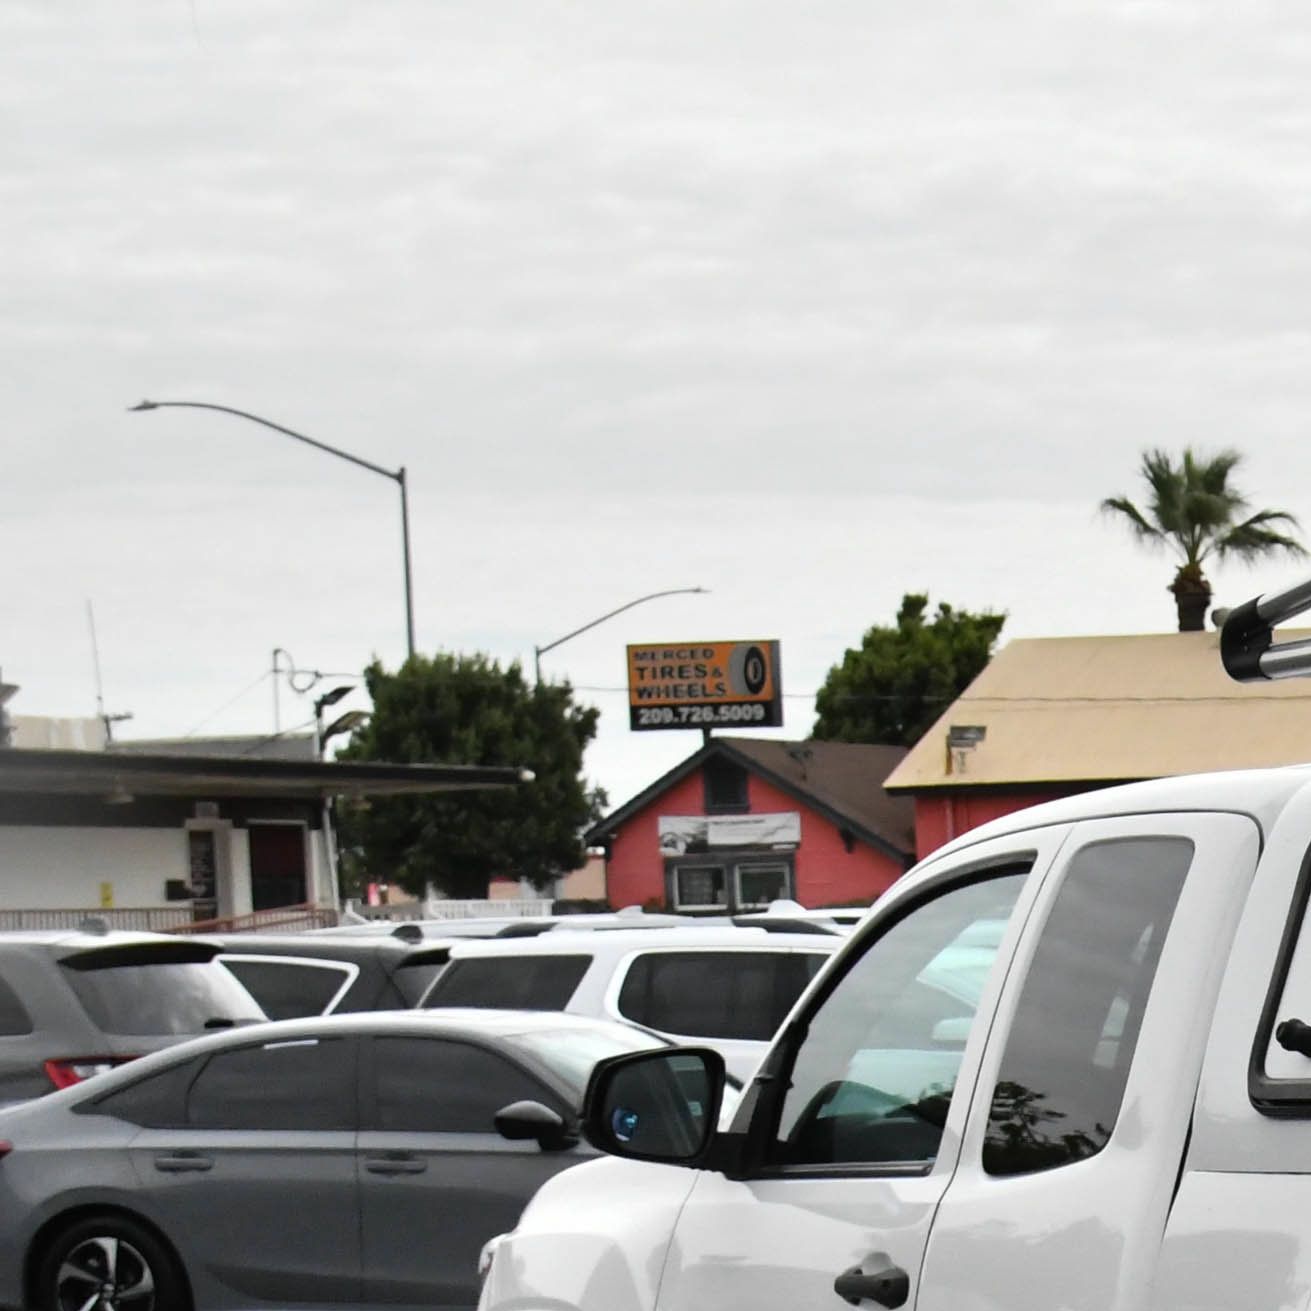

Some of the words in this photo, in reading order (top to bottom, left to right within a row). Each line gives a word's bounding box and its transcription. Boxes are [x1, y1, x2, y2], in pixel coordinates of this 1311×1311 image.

[633, 649, 714, 661] MERCED
[636, 663, 708, 681] TIRES
[712, 667, 723, 678] &
[636, 682, 727, 699] WHEELS
